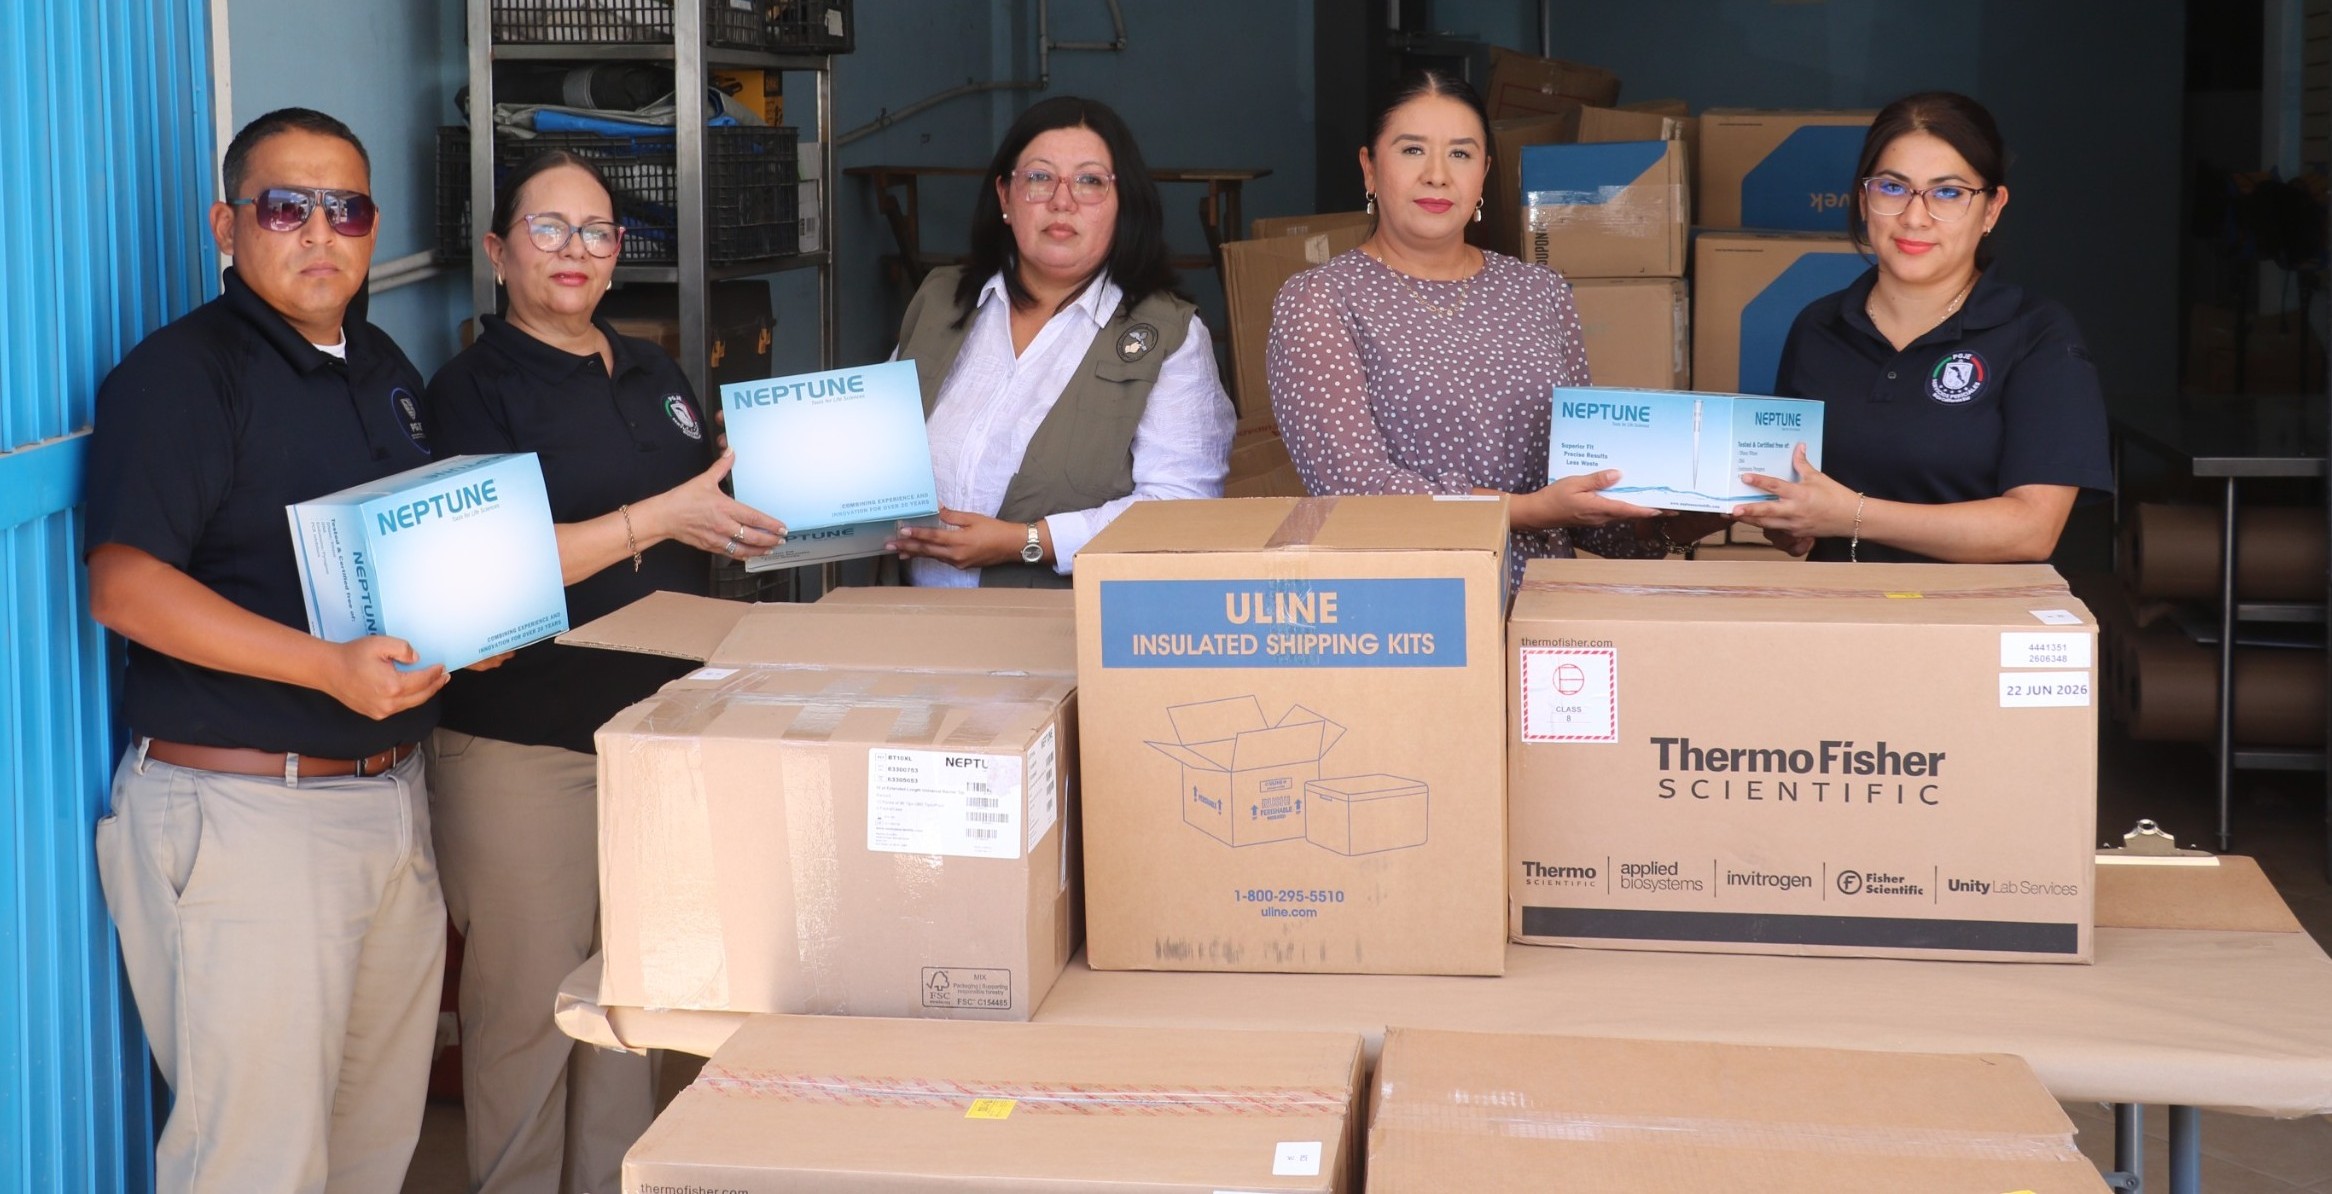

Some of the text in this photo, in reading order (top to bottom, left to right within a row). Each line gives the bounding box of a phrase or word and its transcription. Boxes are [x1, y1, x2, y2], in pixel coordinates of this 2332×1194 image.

[1810, 193, 1850, 212] vek
[734, 375, 864, 410] NEPTUNE
[1562, 402, 1650, 422] NEPTUNE
[1755, 411, 1801, 427] NEPTUNE
[1561, 442, 1585, 451] Superior
[377, 478, 498, 536] NEPTUNE
[841, 500, 876, 509] COMBINING
[877, 494, 914, 504] EXPERIENCE
[785, 527, 854, 542] PTUNE
[352, 551, 378, 636] NEPTUN
[1226, 592, 1338, 624] ULINE
[487, 628, 516, 642] COMBINING
[518, 615, 549, 631] EXPERIENCE
[1133, 633, 1435, 656] INSULATED SHIPPING KITS
[1521, 637, 1613, 648] thermofisher.com
[2029, 655, 2068, 663] 2606348
[2006, 684, 2088, 695] 22 JUN 2026
[945, 757, 989, 770] NEPTU
[1659, 778, 1938, 805] SCIENTIFIC
[1522, 861, 1597, 879] Thermo
[1621, 861, 1678, 876] applied
[1526, 879, 1596, 887] SCIENTIFIC
[1621, 876, 1703, 892] biosystems
[1727, 870, 1812, 890] invitrogen
[1866, 873, 1905, 884] Fisher
[1866, 884, 1923, 895] Scientific
[1948, 878, 2078, 896] Unity Lab Services
[1234, 889, 1344, 903] 1-800-295-5510
[1261, 907, 1317, 918] uline.com
